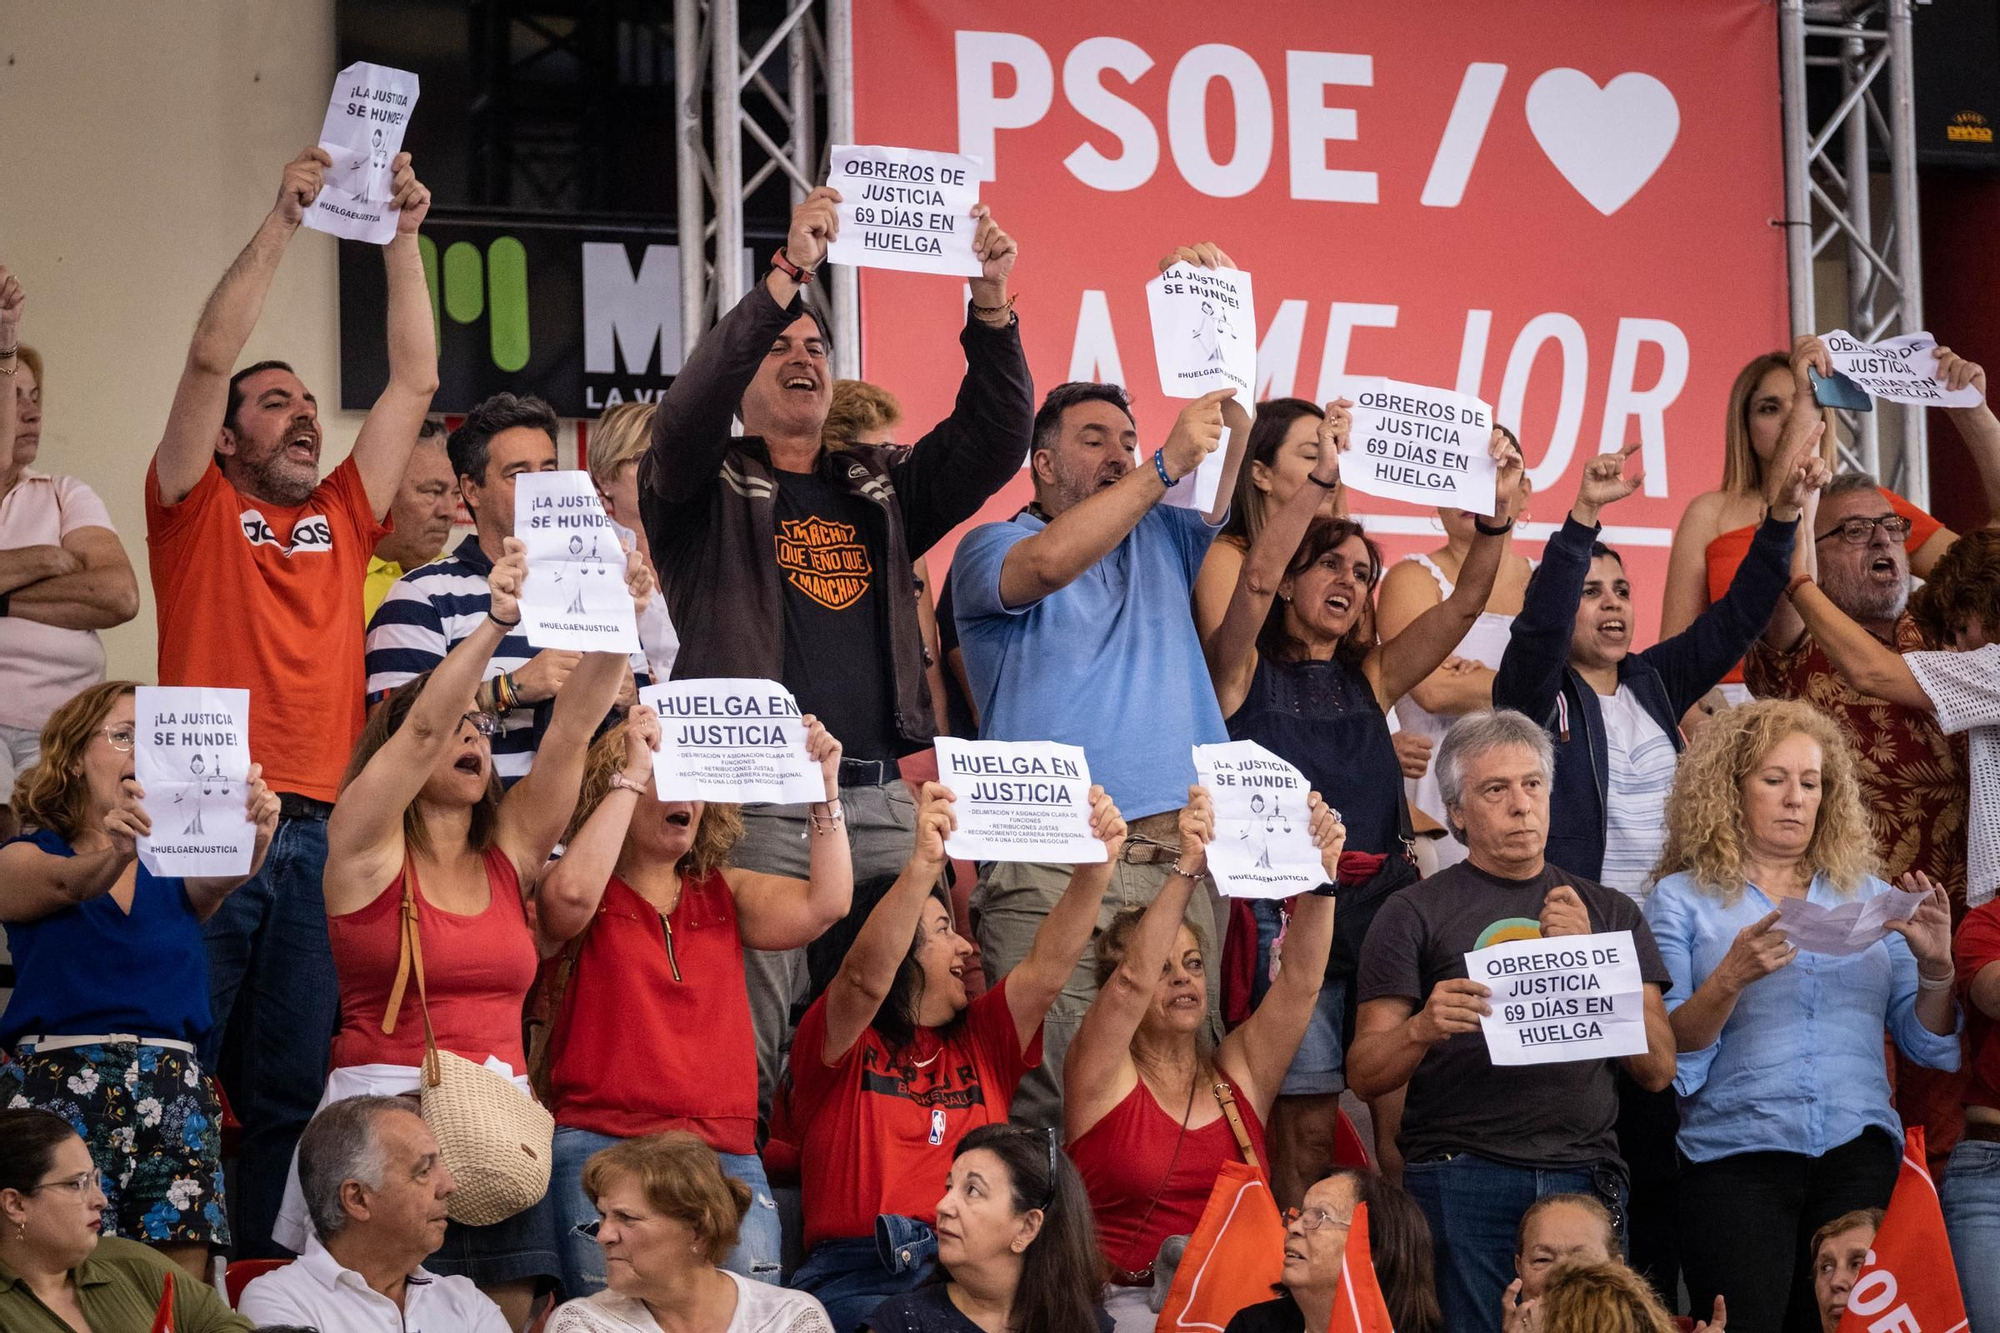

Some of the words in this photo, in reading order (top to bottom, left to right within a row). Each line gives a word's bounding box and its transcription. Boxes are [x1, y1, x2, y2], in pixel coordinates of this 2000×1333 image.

[346, 103, 366, 117] SE
[955, 30, 1379, 203] PSOE
[845, 160, 934, 182] OBREROS
[940, 168, 965, 186] DE
[862, 184, 945, 206] JUSTICIA
[855, 207, 875, 223] 69
[881, 206, 923, 228] DÍAS
[929, 214, 954, 231] EN
[864, 231, 942, 254] HUELGA
[1186, 272, 1237, 294] JUSTICIA
[1164, 284, 1184, 294] SE
[1190, 285, 1240, 309] HUNDE!
[1900, 342, 1925, 359] DE
[1848, 359, 1917, 376] JUSTICIA
[1912, 377, 1937, 389] EN
[1359, 392, 1455, 421] OBREROS
[1461, 409, 1485, 428] DE
[1375, 416, 1461, 446] JUSTICIA
[1367, 438, 1388, 454] 69
[1394, 441, 1437, 465] DÍAS
[1443, 452, 1469, 471] EN
[1376, 463, 1456, 489] HUELGA
[532, 496, 553, 511] ¡LA
[531, 516, 551, 528] SE
[781, 543, 807, 566] QUE
[842, 551, 865, 570] QUE
[800, 574, 860, 604] MARCHAR
[540, 622, 620, 633] #HUELGAENJUSTICIA
[657, 696, 761, 715] HUELGA
[769, 697, 800, 716] EN
[155, 713, 177, 727] ¡LA
[181, 713, 233, 725] JUSTICIA
[154, 732, 175, 746] SE
[182, 733, 238, 746] HUNDE!
[677, 725, 787, 745] JUSTICIA
[951, 753, 1047, 775] HUELGA
[1051, 757, 1079, 777] EN
[1213, 760, 1233, 770] ¡LA
[1237, 760, 1292, 773] JUSTICIA
[970, 782, 1072, 803] JUSTICIA
[1216, 774, 1236, 786] SE
[1242, 775, 1298, 789] HUNDE!
[151, 845, 238, 854] #HUELGAENJUSTICIA
[1486, 950, 1588, 976] OBREROS
[1592, 948, 1620, 965] DE
[1509, 973, 1600, 998] JUSTICIA
[1504, 1004, 1525, 1022] 69
[1532, 997, 1578, 1019] DÍAS
[1586, 996, 1613, 1013] EN
[1519, 1021, 1603, 1044] HUELGA
